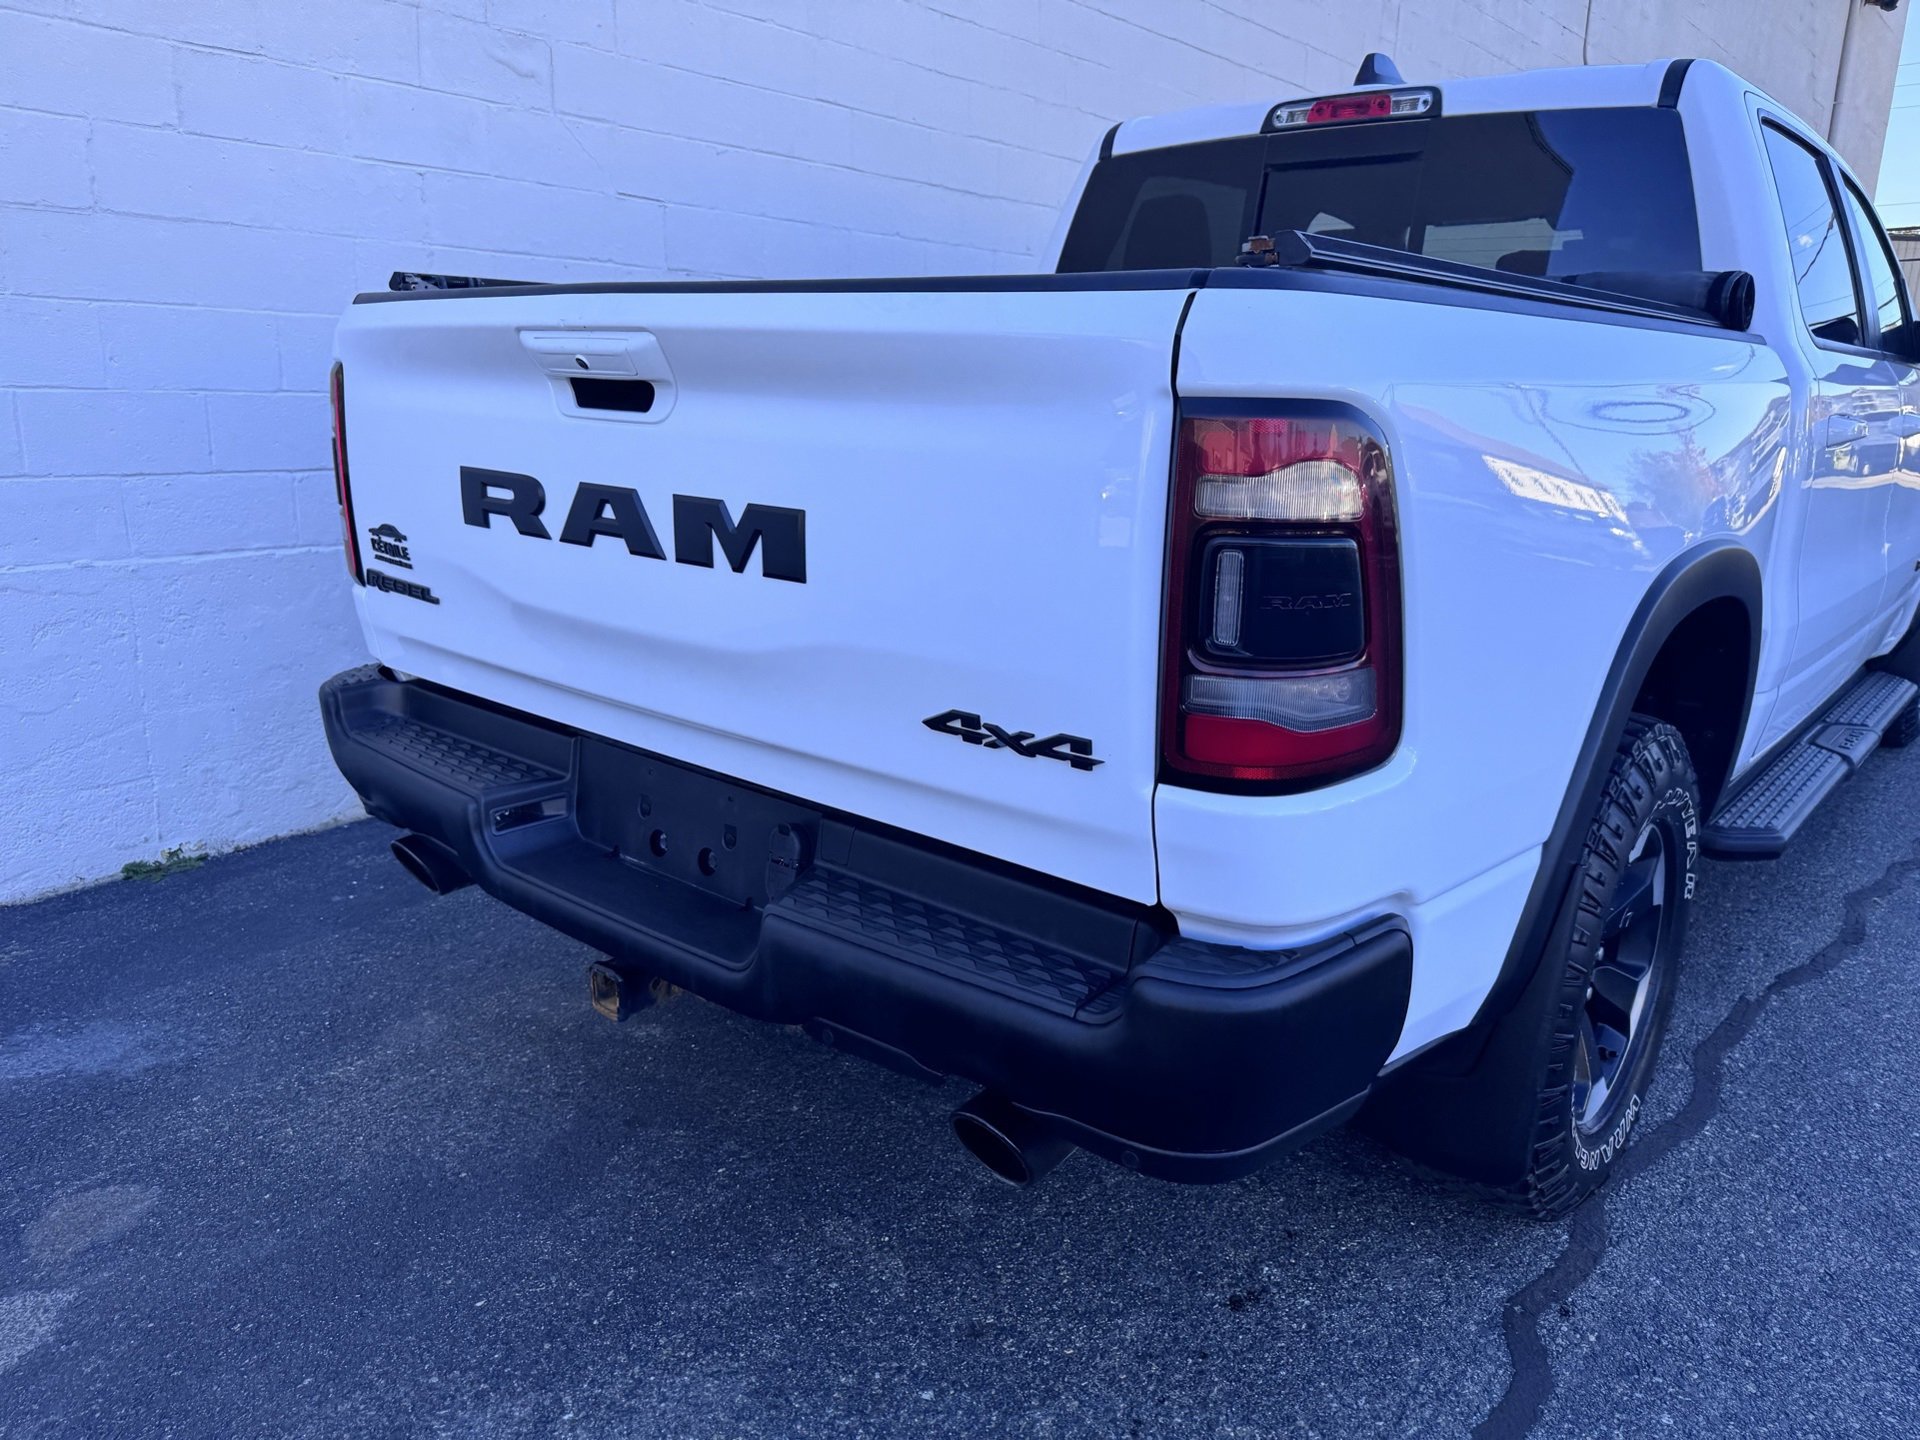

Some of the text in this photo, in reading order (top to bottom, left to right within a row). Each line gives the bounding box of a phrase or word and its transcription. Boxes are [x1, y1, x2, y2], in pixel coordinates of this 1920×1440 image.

[459, 465, 807, 584] RAM
[366, 568, 441, 605] REBEL
[1258, 592, 1352, 610] RAM
[1571, 1094, 1641, 1171] WRANGL
